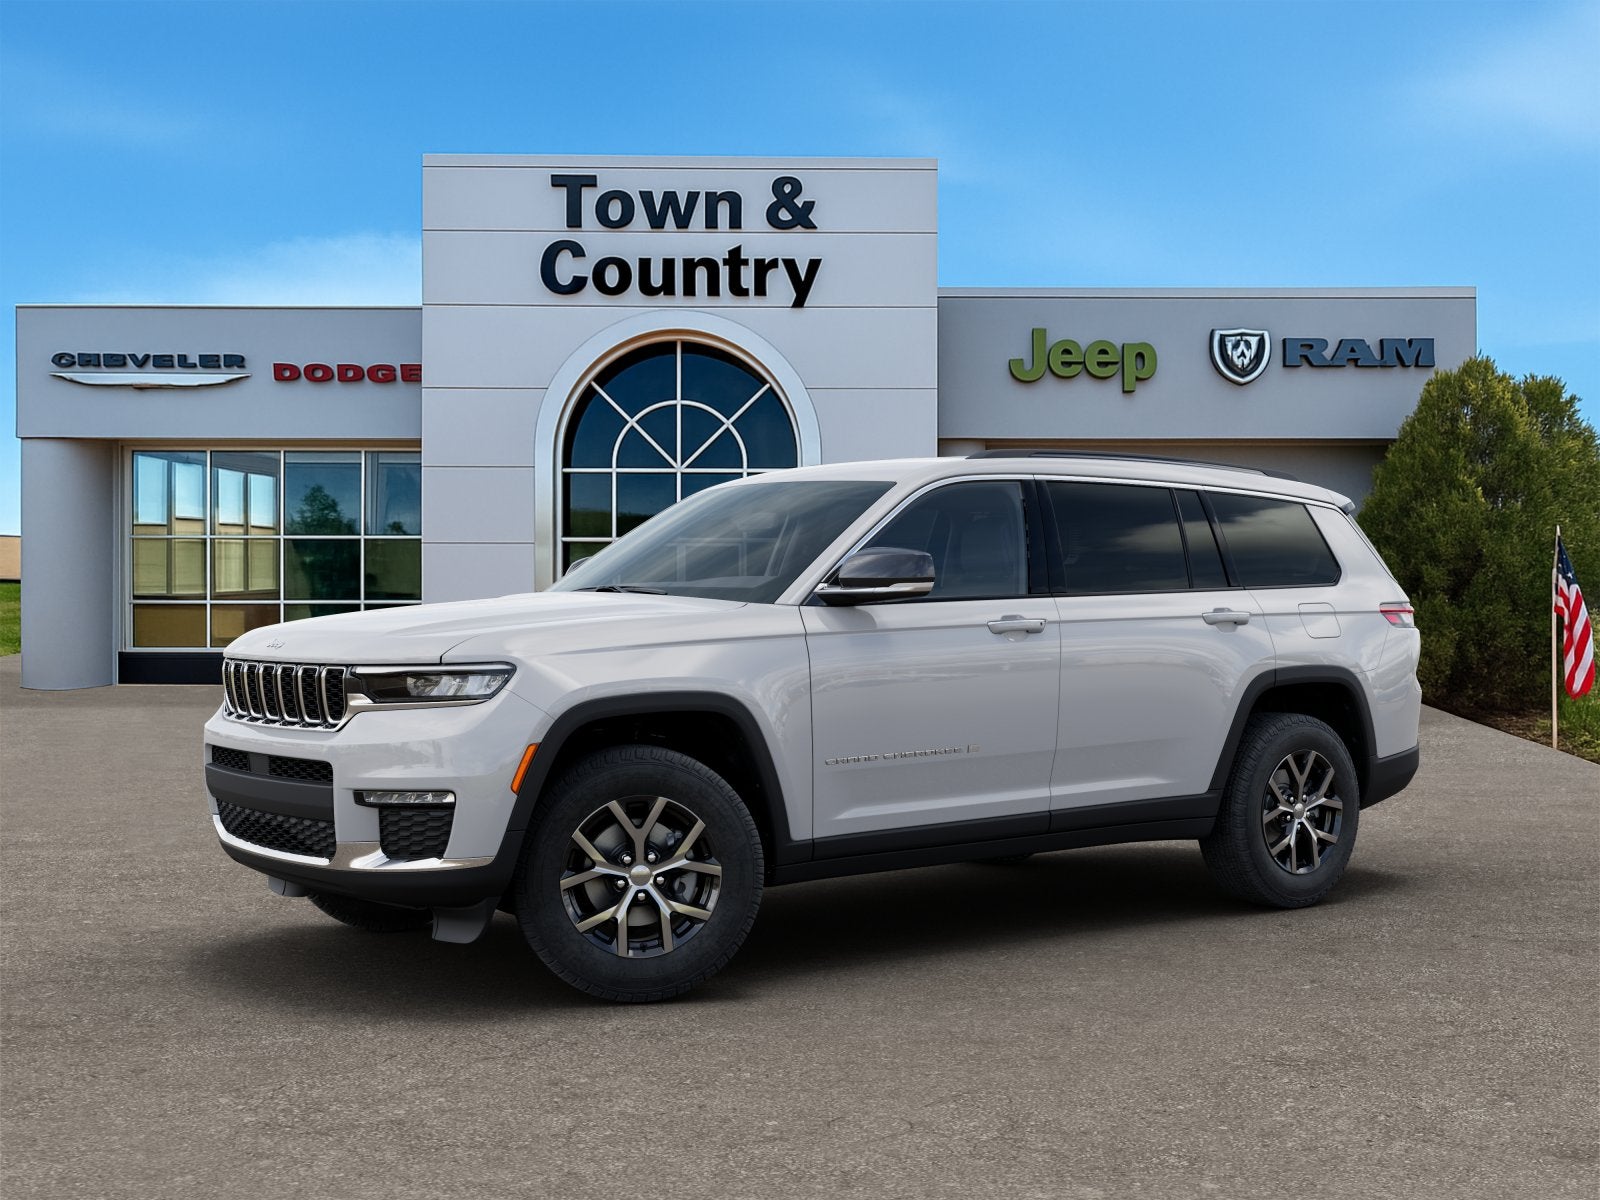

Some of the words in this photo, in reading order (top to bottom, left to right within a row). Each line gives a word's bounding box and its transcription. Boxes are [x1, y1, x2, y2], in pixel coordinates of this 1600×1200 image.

[550, 174, 743, 230] Town
[765, 175, 818, 231] &
[539, 239, 823, 308] Country
[272, 362, 422, 383] DODGE
[1009, 327, 1158, 393] Jeep
[1282, 337, 1436, 368] RAM
